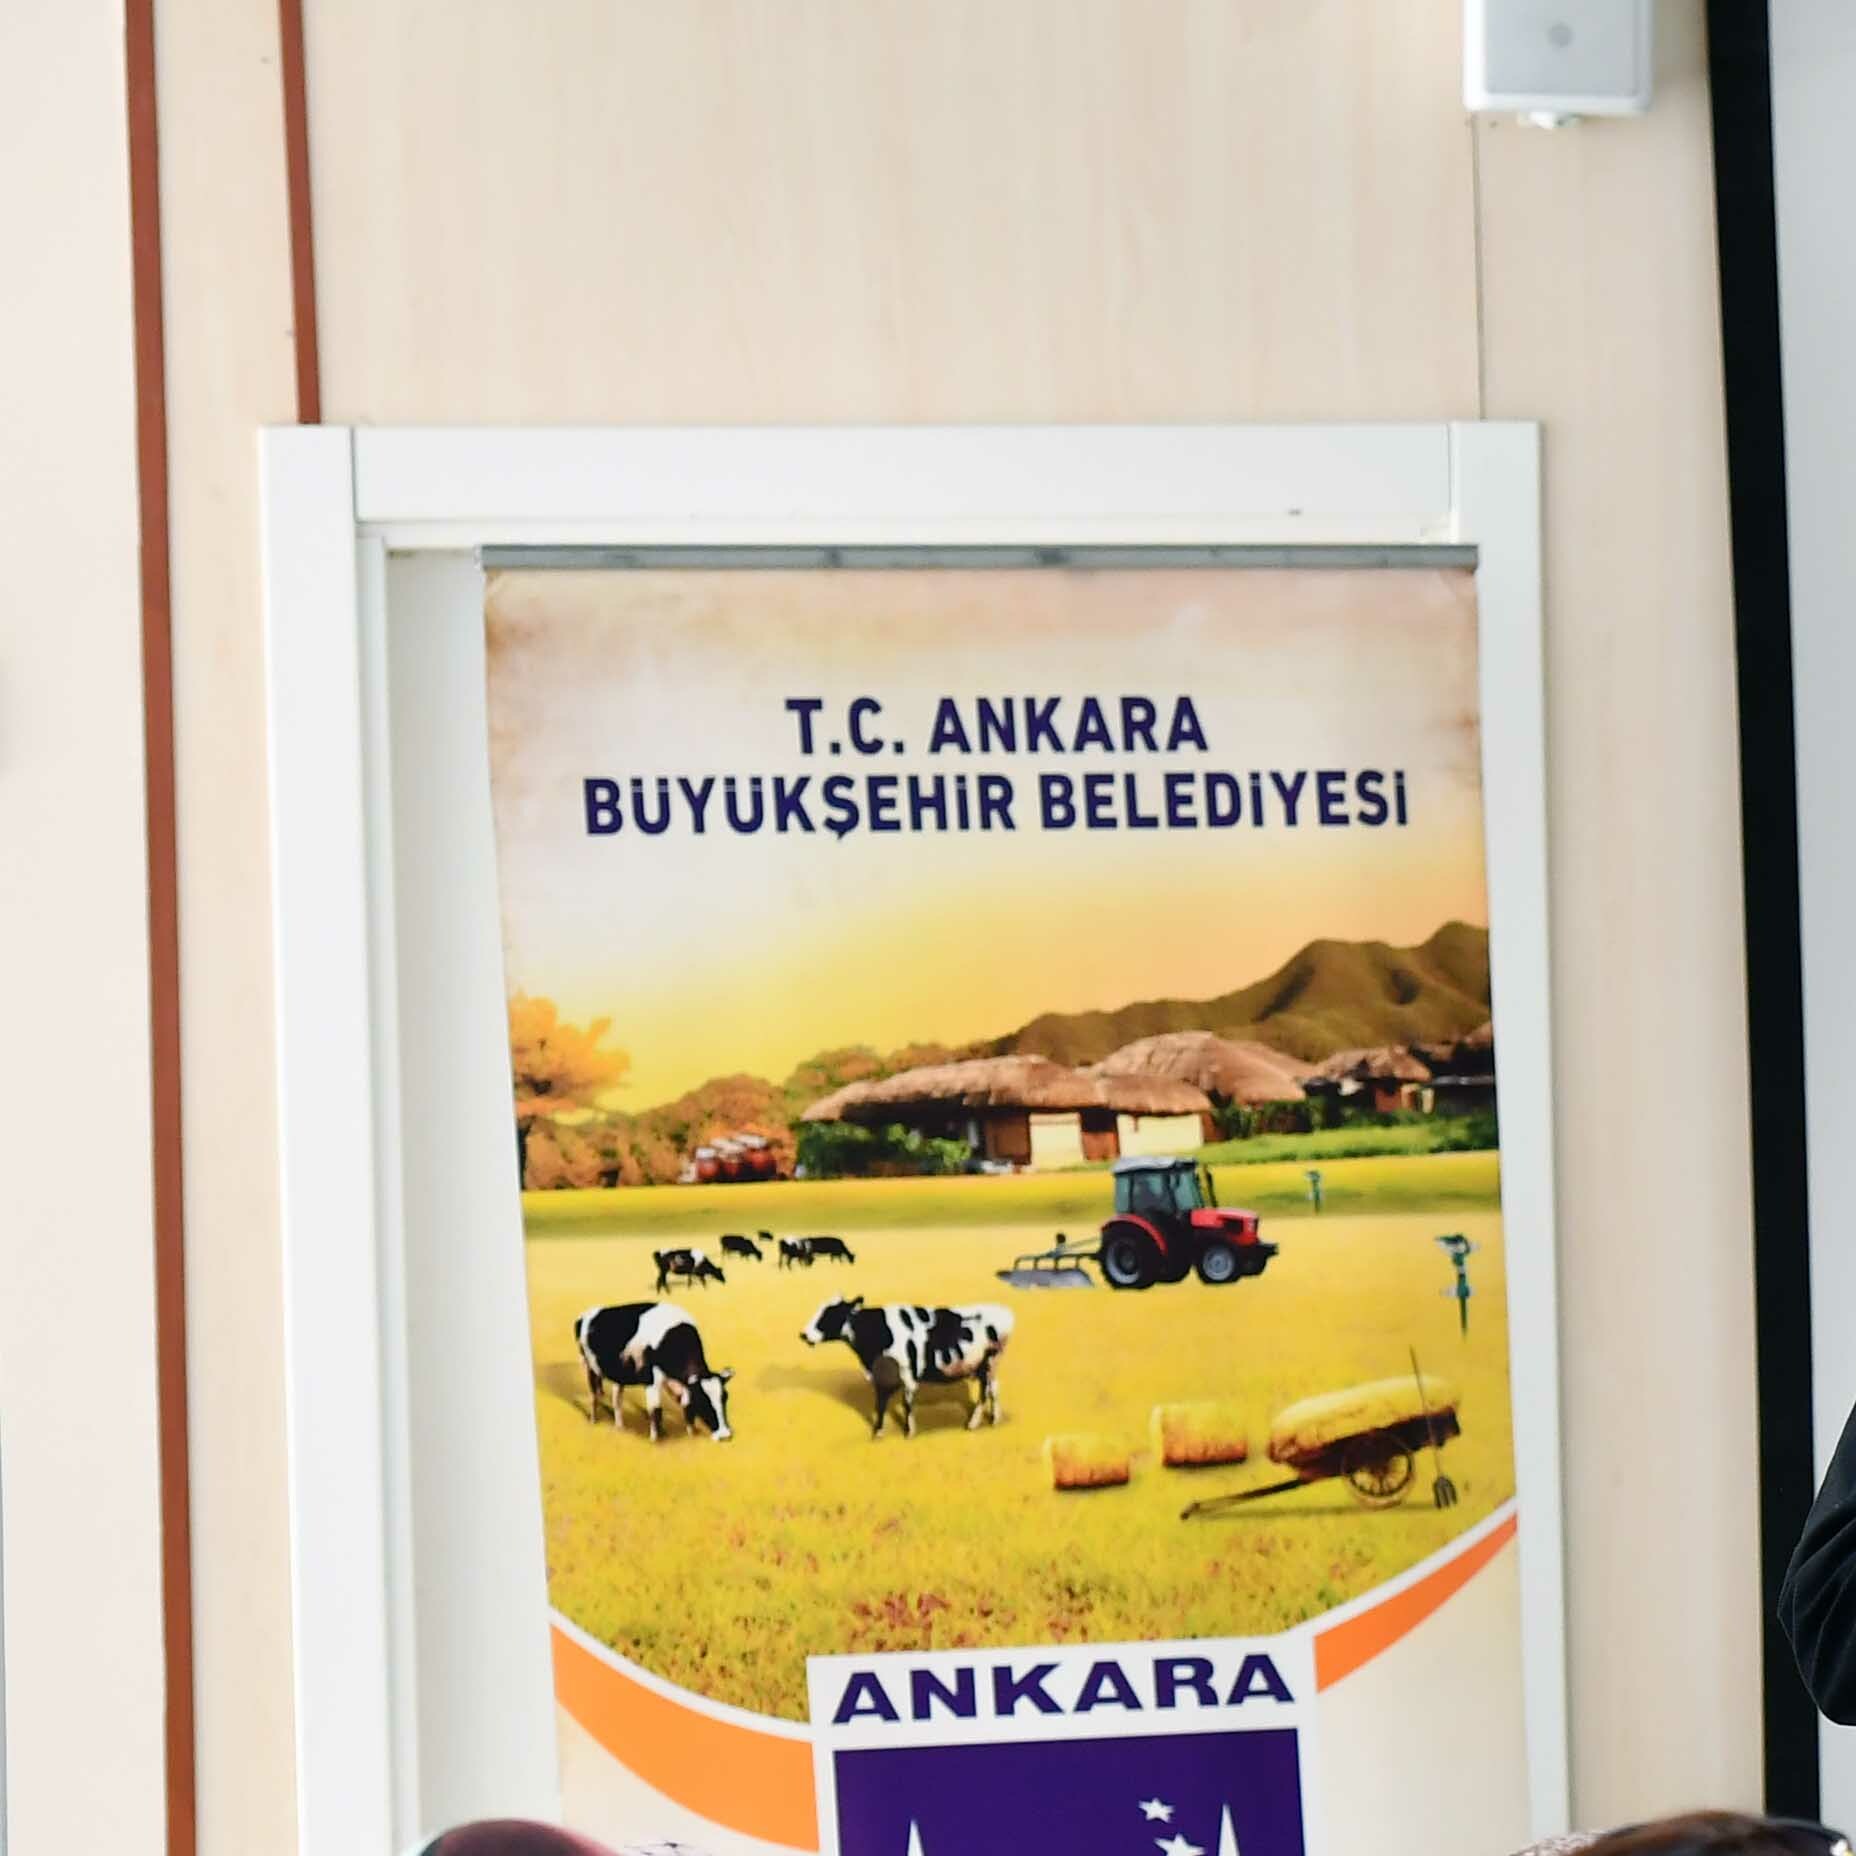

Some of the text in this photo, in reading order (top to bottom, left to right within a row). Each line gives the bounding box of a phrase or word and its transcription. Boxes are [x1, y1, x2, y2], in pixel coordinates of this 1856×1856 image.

[786, 697, 1208, 754] T.C. ANKARA
[584, 770, 1407, 838] BÜYÜKŞEHİR BELEDİYESİ
[832, 1654, 1295, 1725] ANKARA
